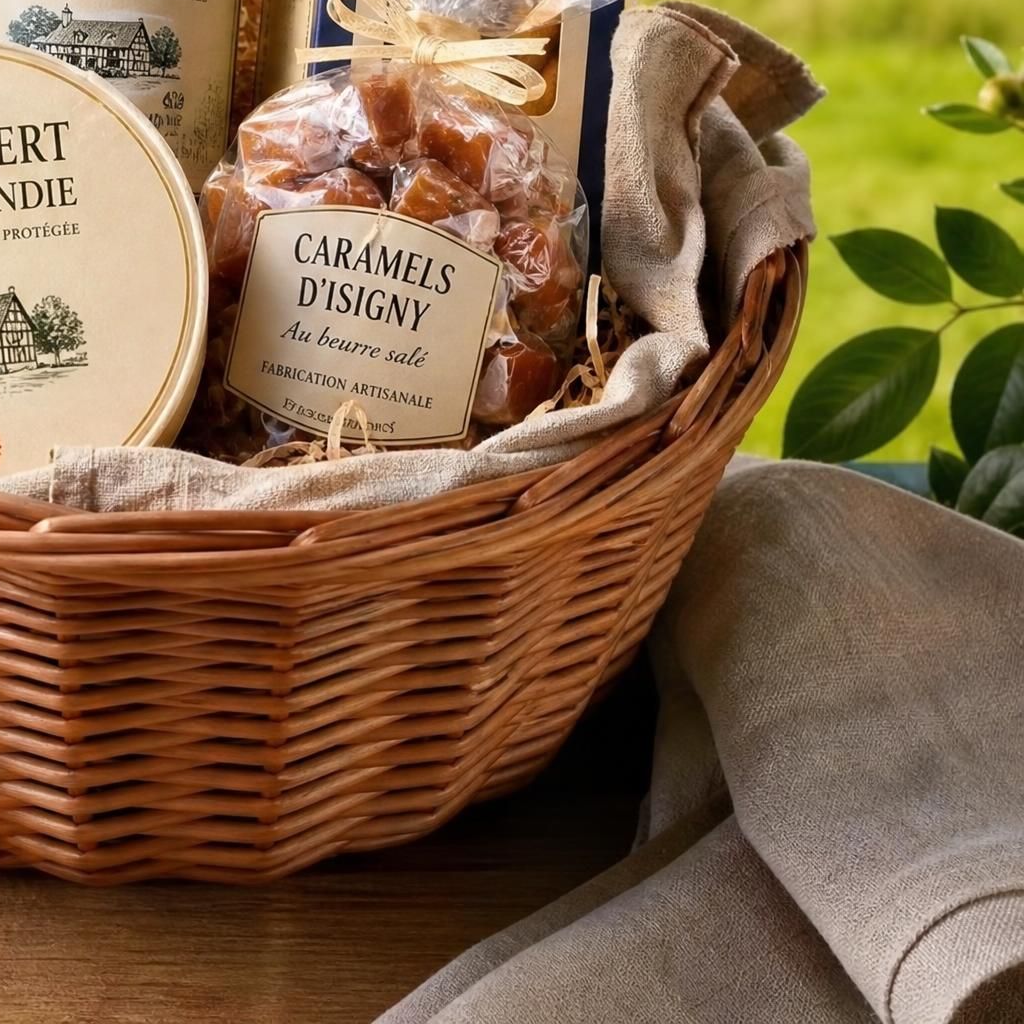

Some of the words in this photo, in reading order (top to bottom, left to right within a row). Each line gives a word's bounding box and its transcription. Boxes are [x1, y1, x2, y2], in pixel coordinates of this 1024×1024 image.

[3, 222, 80, 240] PROTÉGÉE
[294, 233, 456, 295] CARAMELS
[297, 276, 431, 332] D'ISIGNY
[280, 320, 312, 343] Au
[317, 326, 380, 359] beurre
[385, 347, 429, 368] salé
[261, 360, 347, 390] FABRICATION
[350, 382, 433, 409] ARTISANALE
